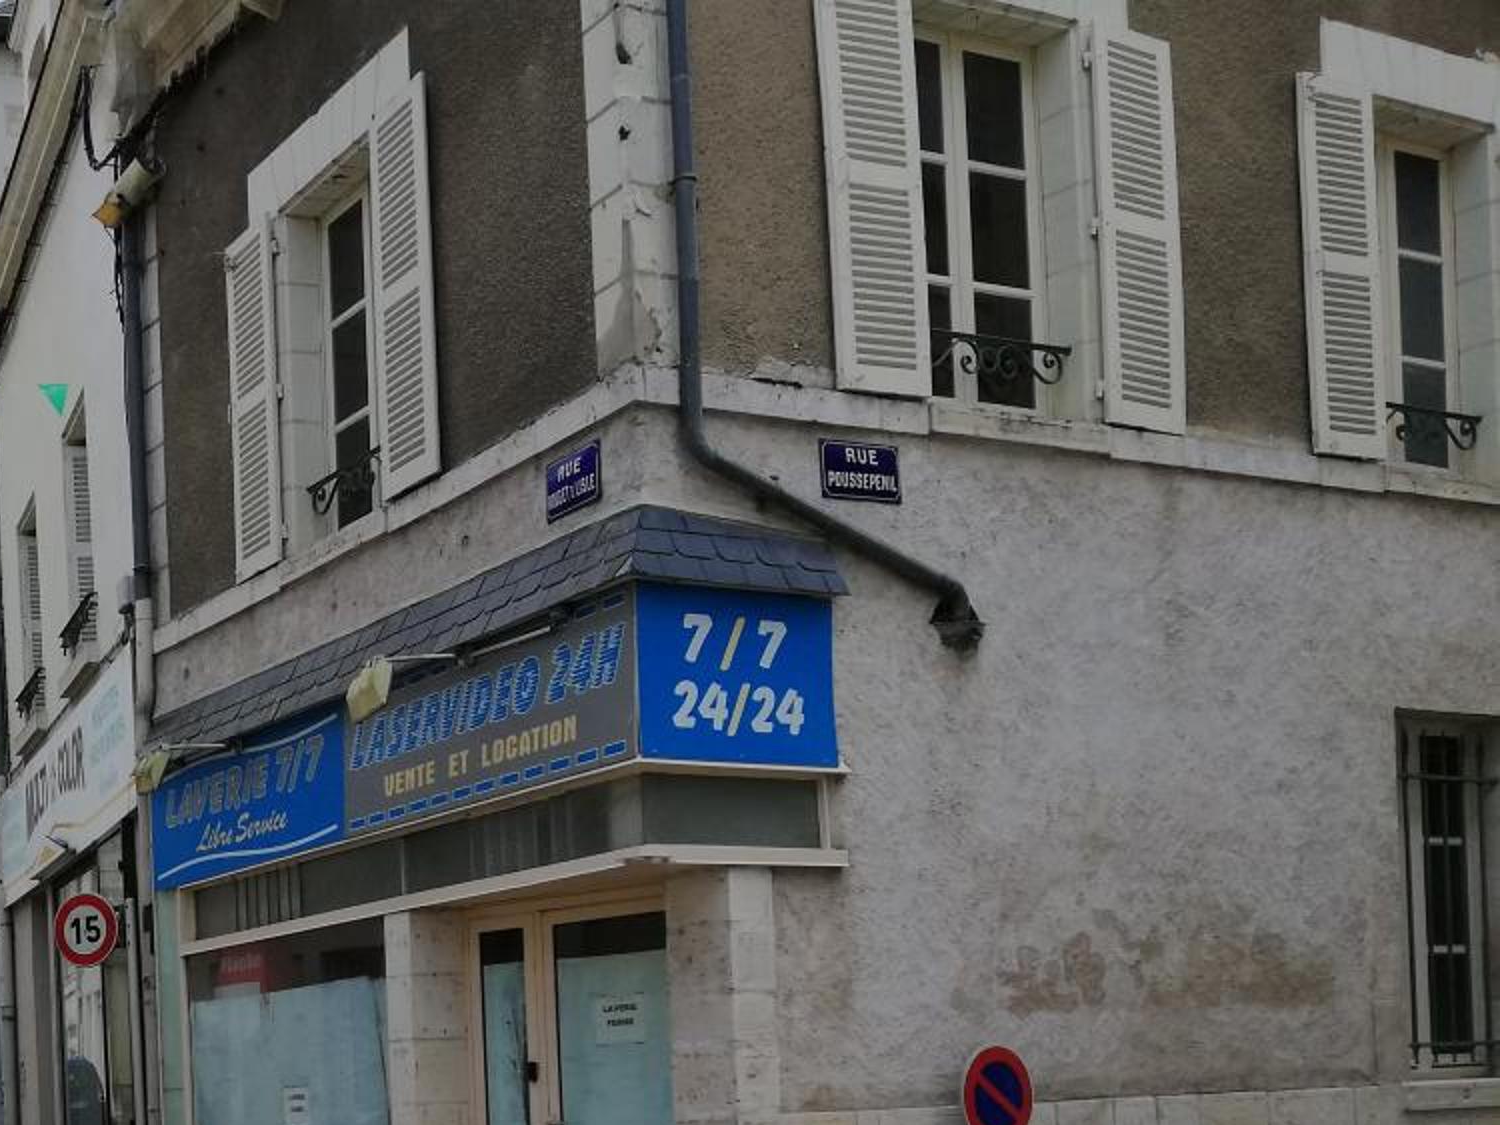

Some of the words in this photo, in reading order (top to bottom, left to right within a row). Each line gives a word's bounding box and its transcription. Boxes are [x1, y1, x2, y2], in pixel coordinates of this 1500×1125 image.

[557, 456, 582, 482] RUE
[845, 447, 879, 466] RUE
[545, 622, 626, 704] 24H
[672, 679, 805, 737] 24/24
[384, 760, 436, 797] VENTE
[448, 749, 470, 778] ET
[481, 714, 578, 768] LOCATION
[165, 753, 270, 829] LAVERIE
[275, 734, 325, 794] 7/7
[196, 820, 234, 852] Libre
[235, 809, 289, 843] Service
[70, 915, 101, 945] 15
